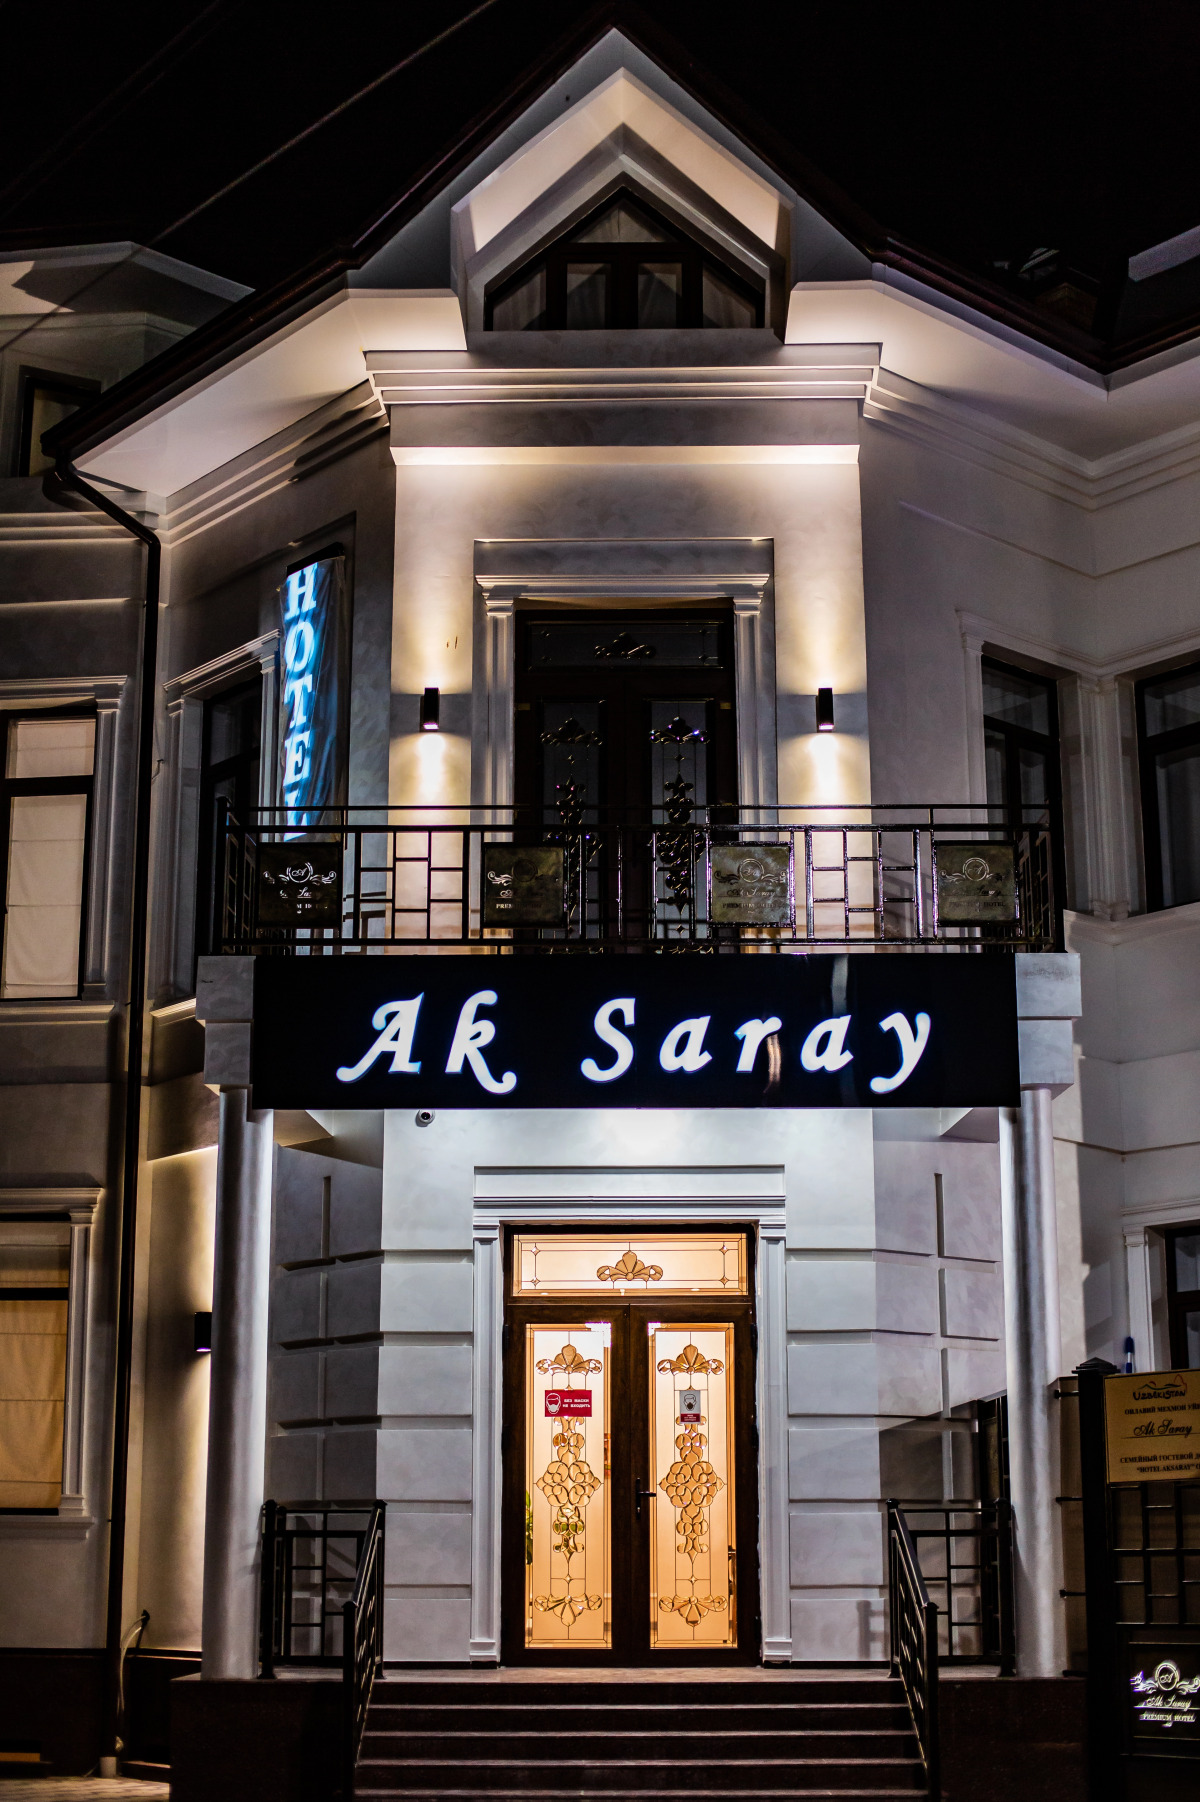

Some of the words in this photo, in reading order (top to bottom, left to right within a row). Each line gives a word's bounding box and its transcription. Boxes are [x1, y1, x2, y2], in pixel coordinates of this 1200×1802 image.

[283, 562, 318, 842] HOTEL
[335, 990, 517, 1095] Ak
[580, 997, 932, 1095] Saray
[1120, 1454, 1158, 1463] СЕМЕЙНЫЙ
[1159, 1451, 1194, 1461] ГОСТЕВОЙ
[1133, 1421, 1156, 1437] Ak
[1157, 1419, 1193, 1438] Saray
